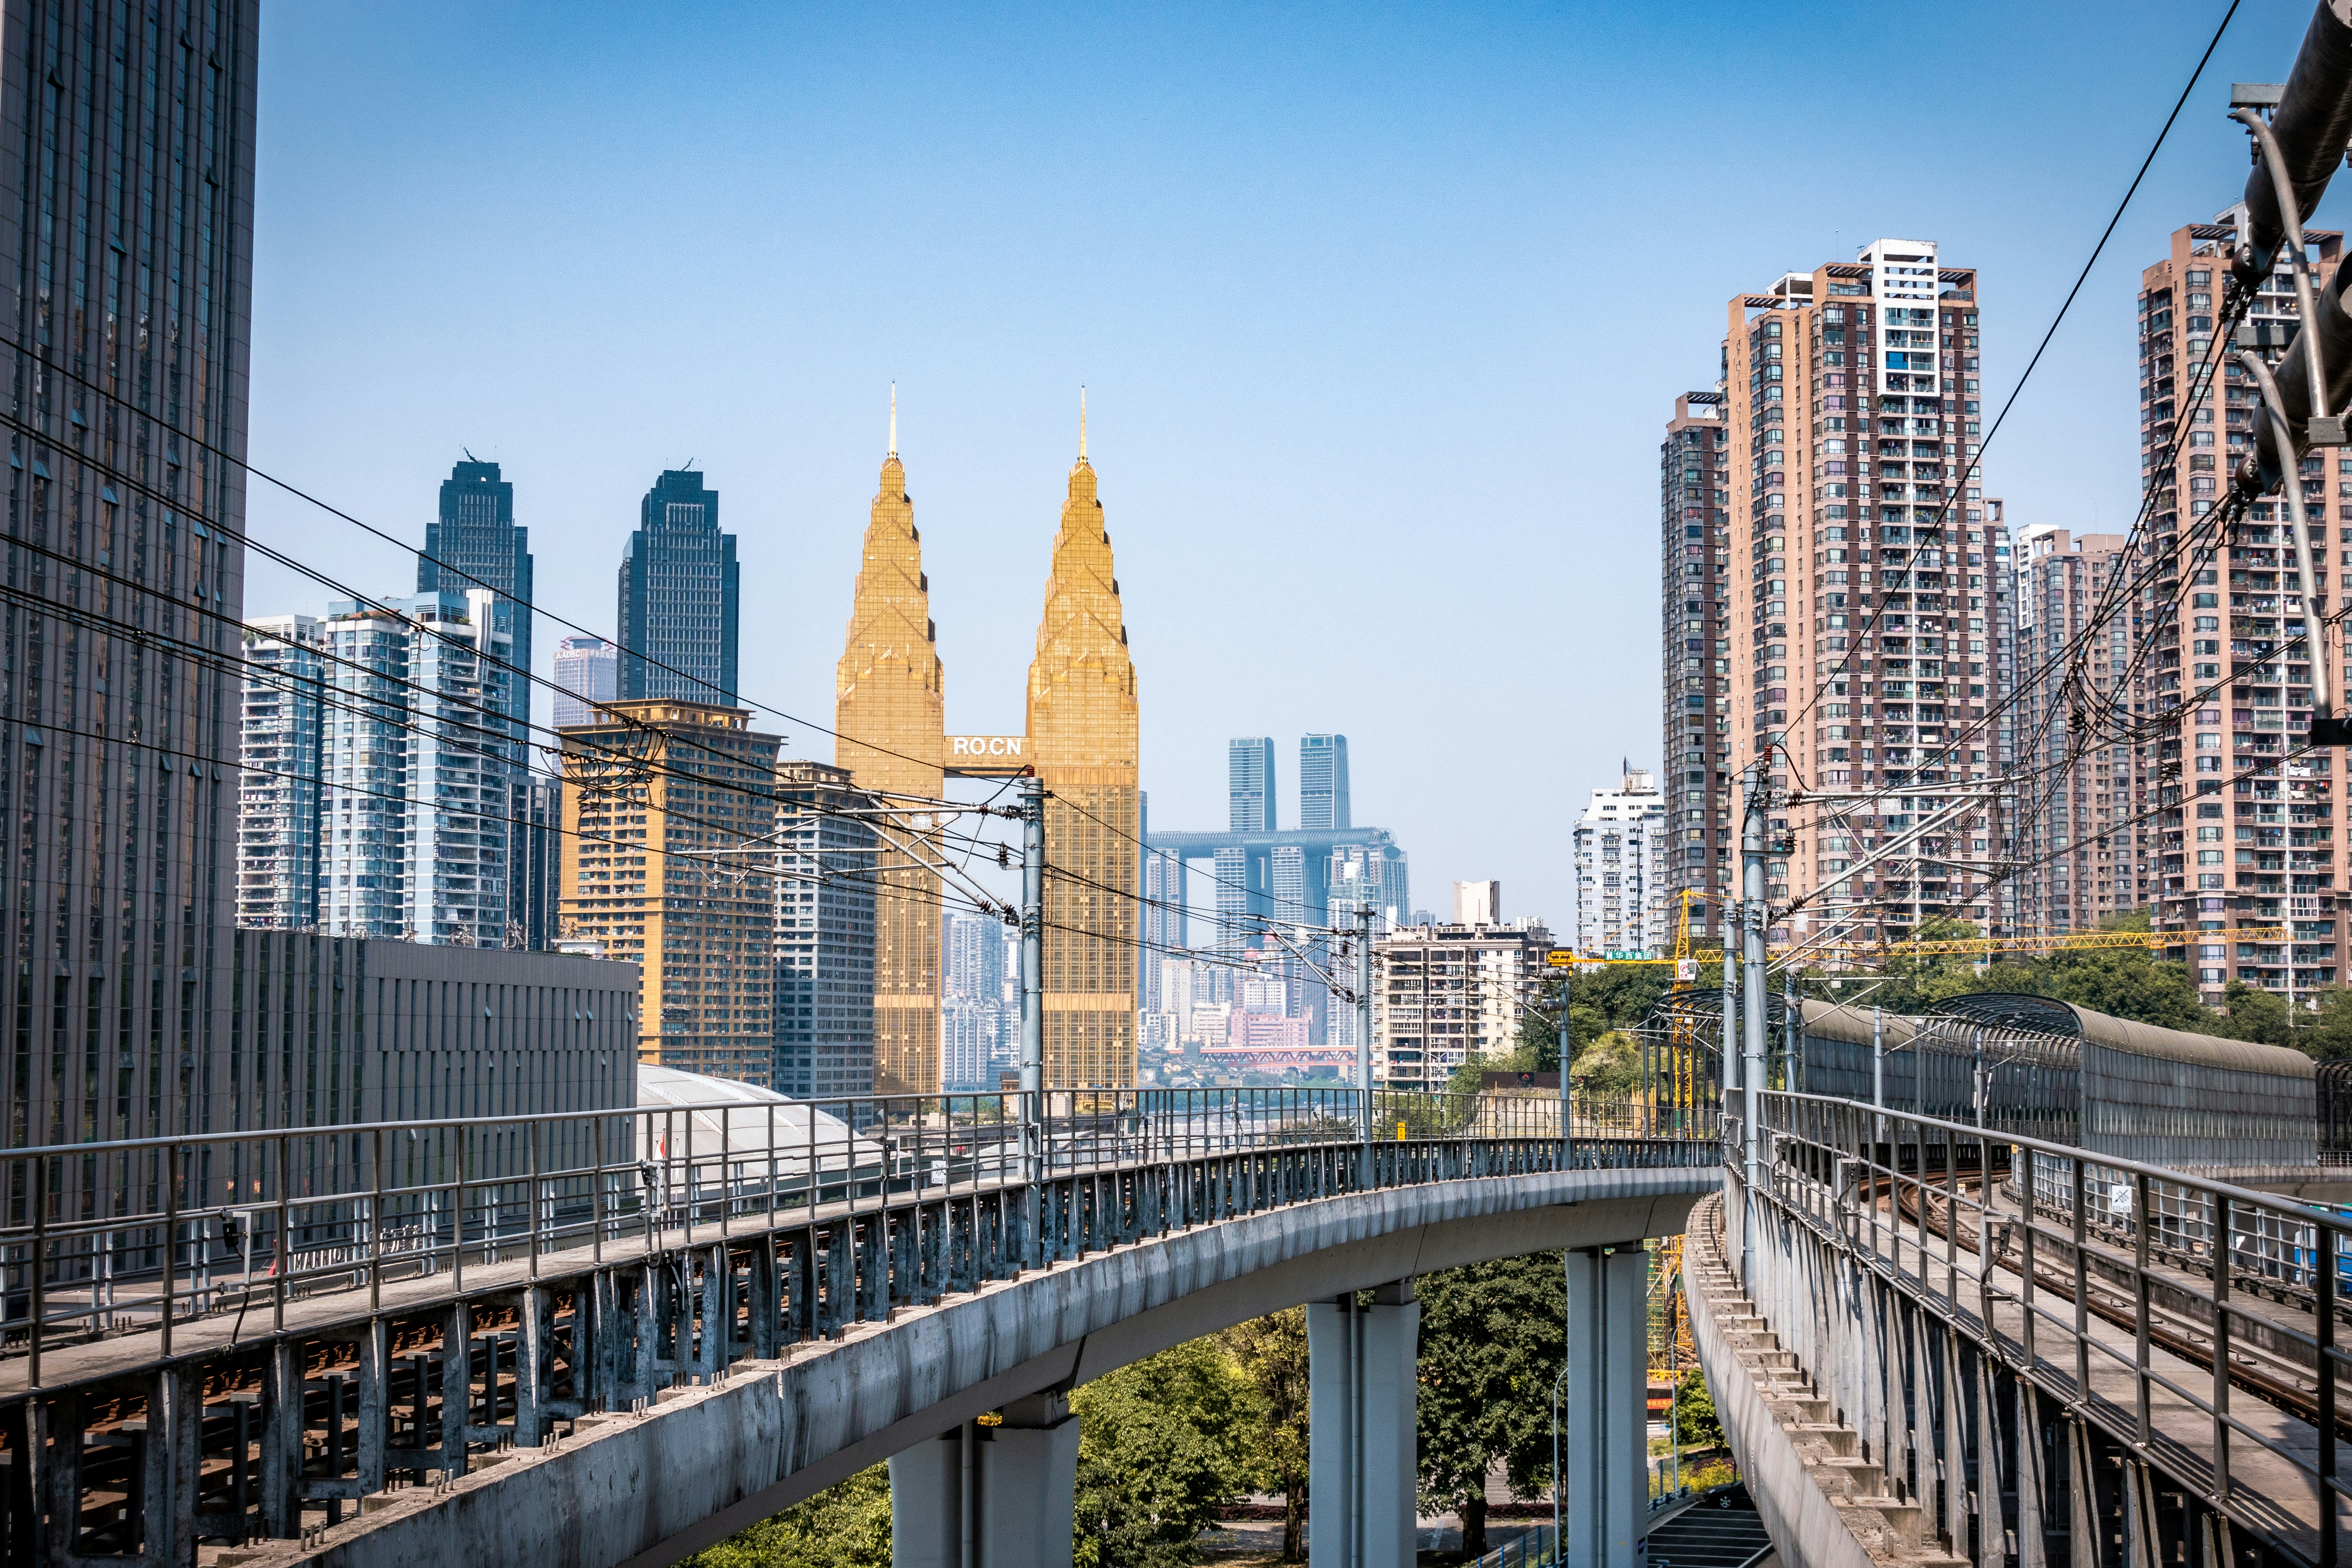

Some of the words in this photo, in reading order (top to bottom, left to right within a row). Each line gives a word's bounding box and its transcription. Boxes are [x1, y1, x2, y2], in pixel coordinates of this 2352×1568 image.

[954, 737, 1021, 755] RO.CN
[1615, 952, 1652, 960] 华西集团
